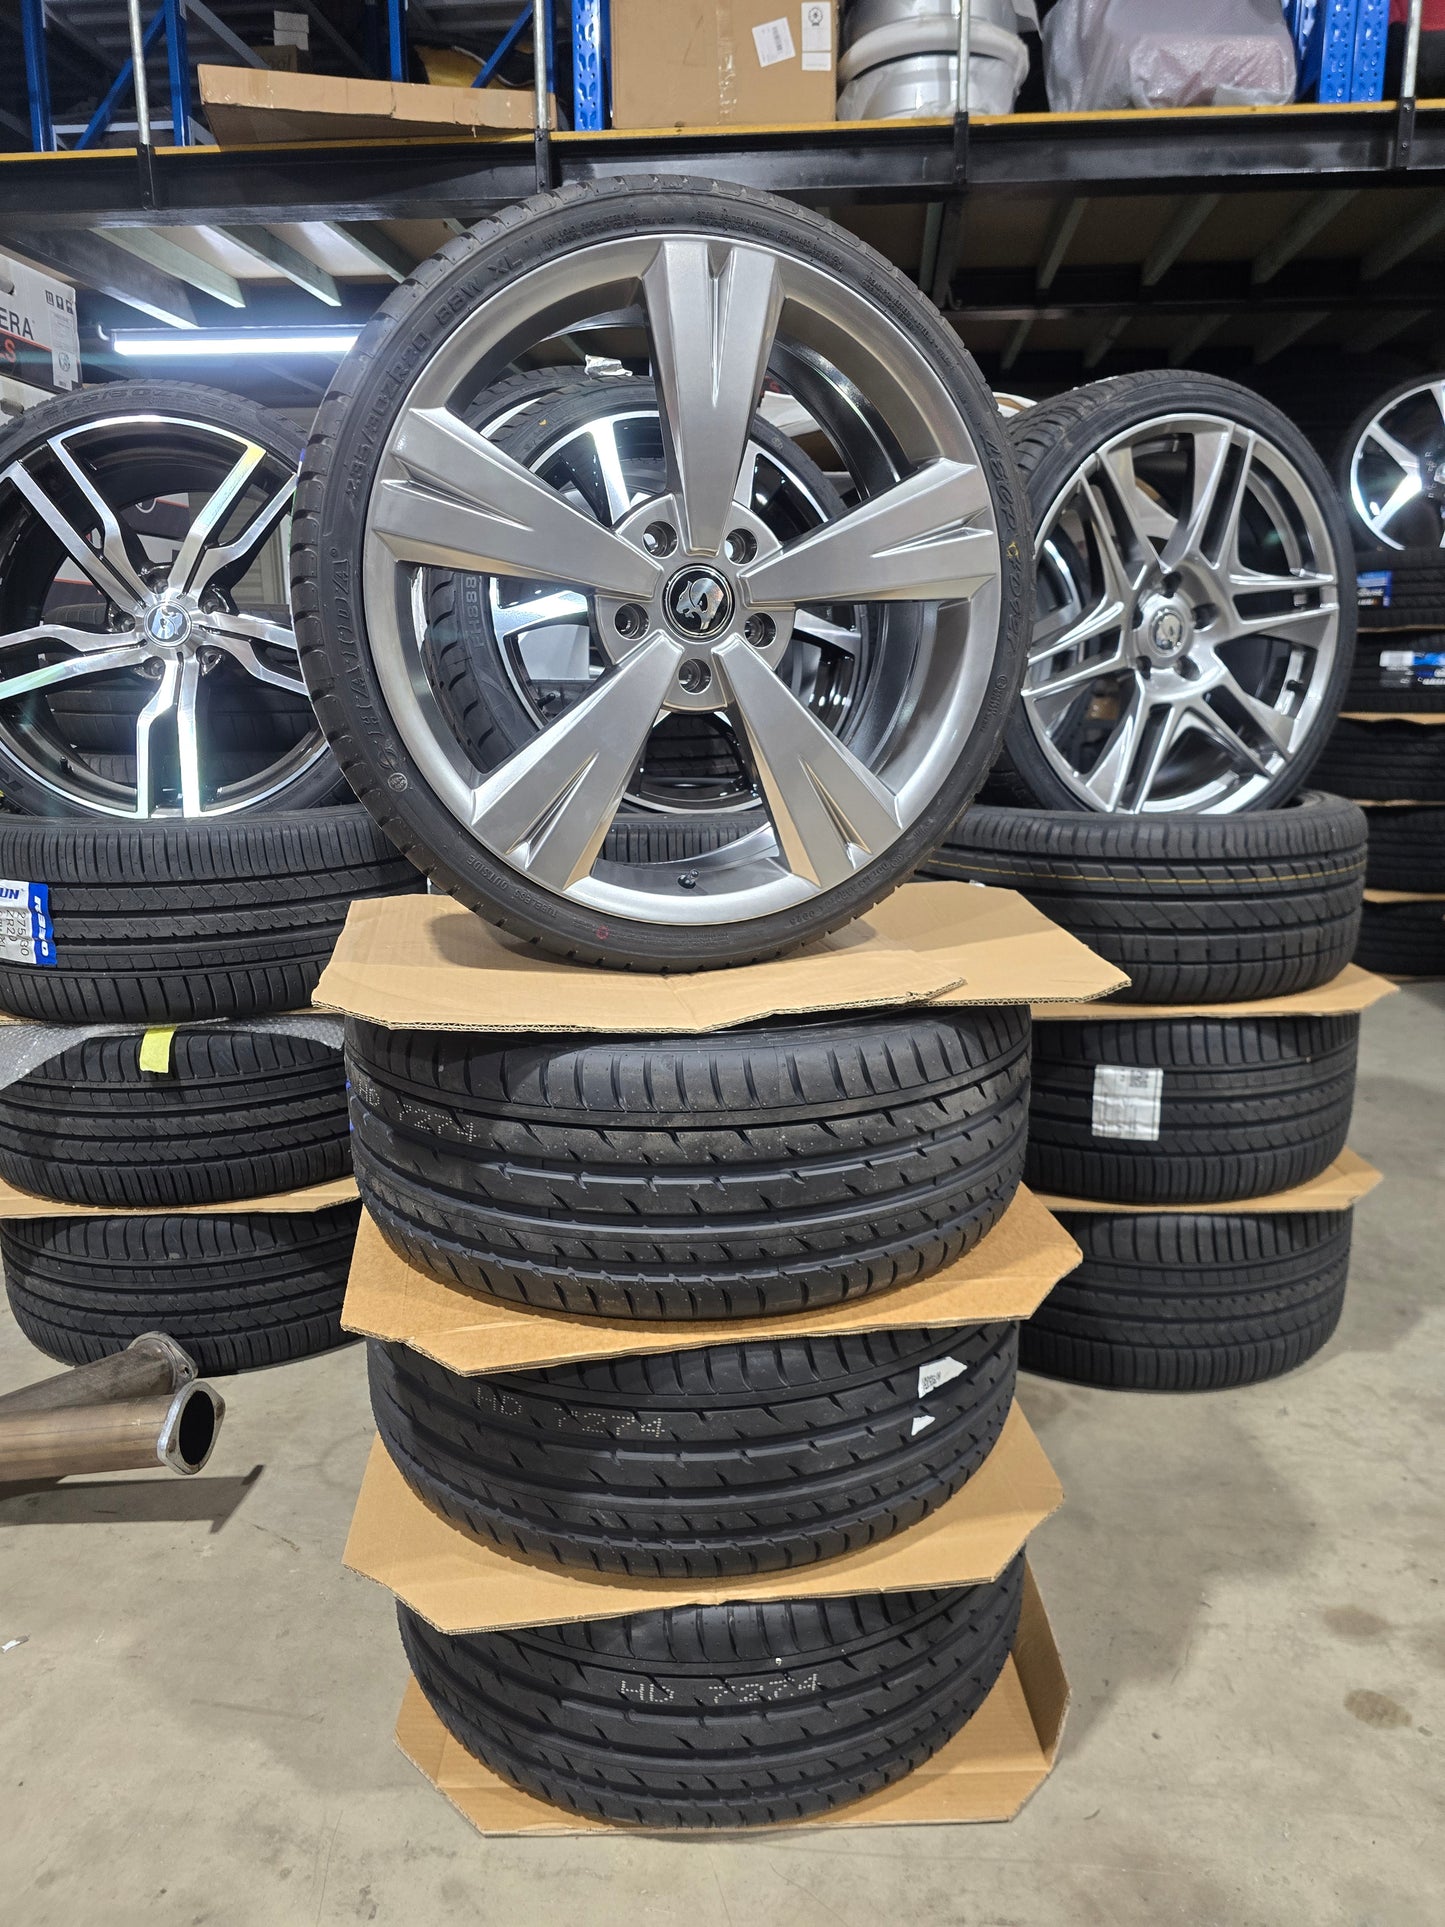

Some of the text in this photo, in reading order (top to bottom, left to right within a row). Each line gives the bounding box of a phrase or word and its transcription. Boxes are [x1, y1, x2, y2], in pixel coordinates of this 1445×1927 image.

[487, 254, 523, 281] XL
[466, 854, 509, 890] OUTSIDE
[17, 910, 30, 957] 275/30
